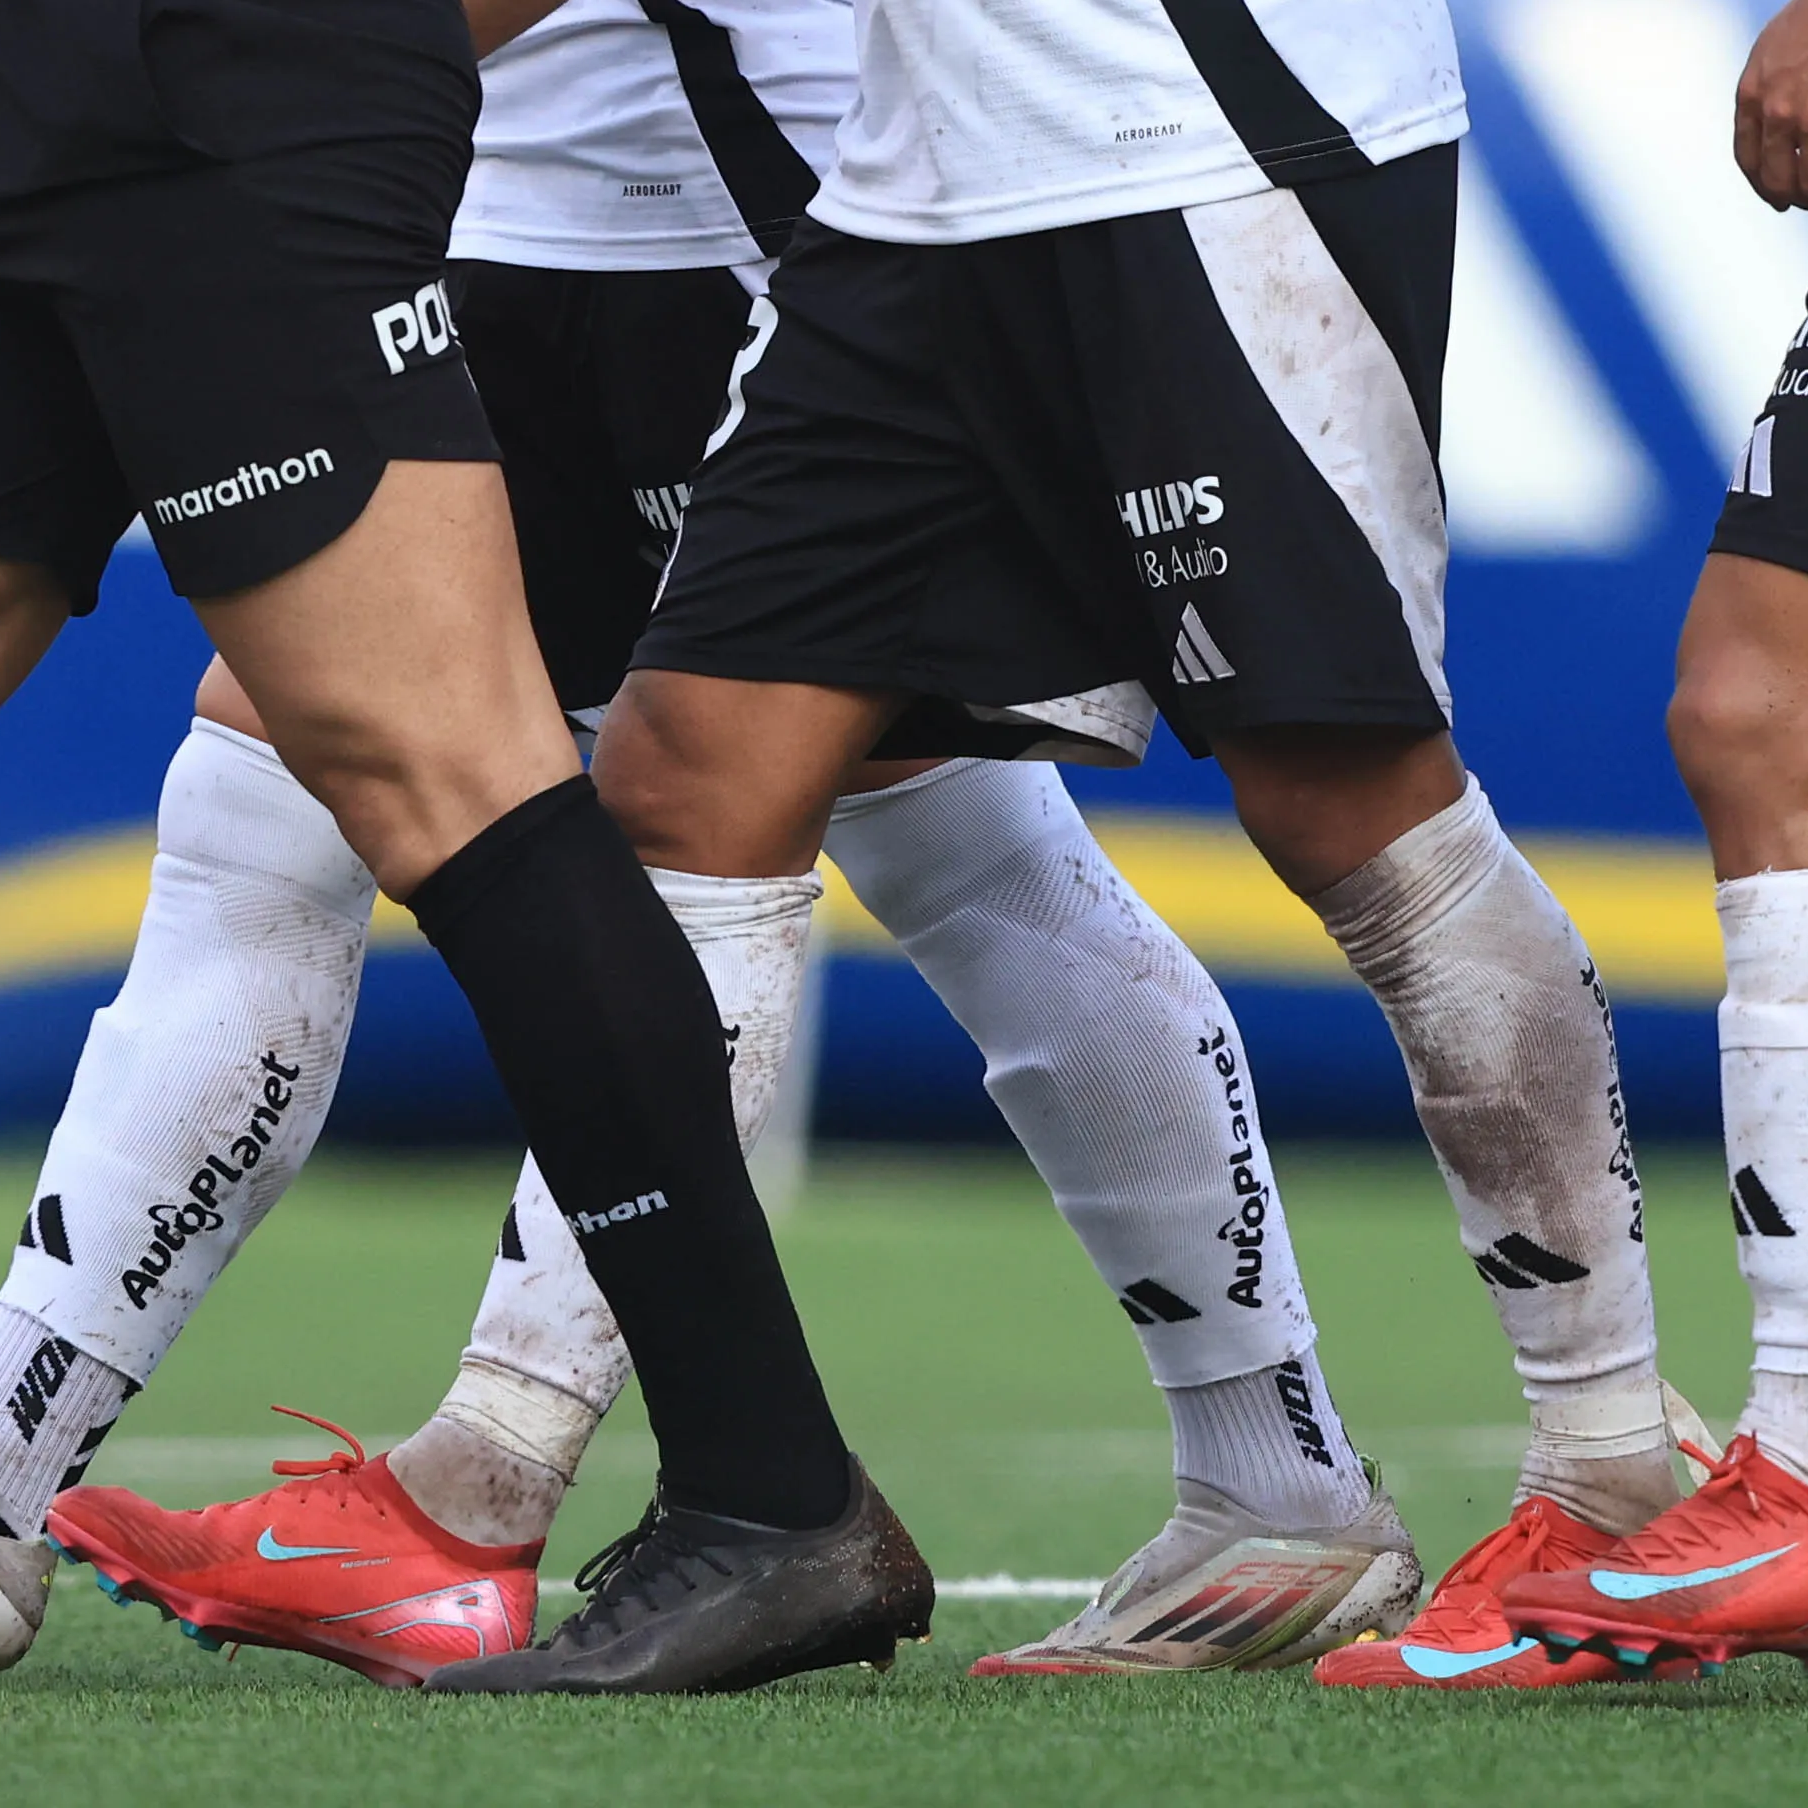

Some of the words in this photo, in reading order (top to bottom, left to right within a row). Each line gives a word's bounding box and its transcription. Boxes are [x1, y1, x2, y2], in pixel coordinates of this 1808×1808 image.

[1115, 123, 1182, 143] AEROREADY
[623, 183, 682, 197] AEROREADY
[155, 446, 335, 525] marathon
[121, 1050, 301, 1310] AutoPlanet
[1196, 1026, 1269, 1309] AutoPlanet
